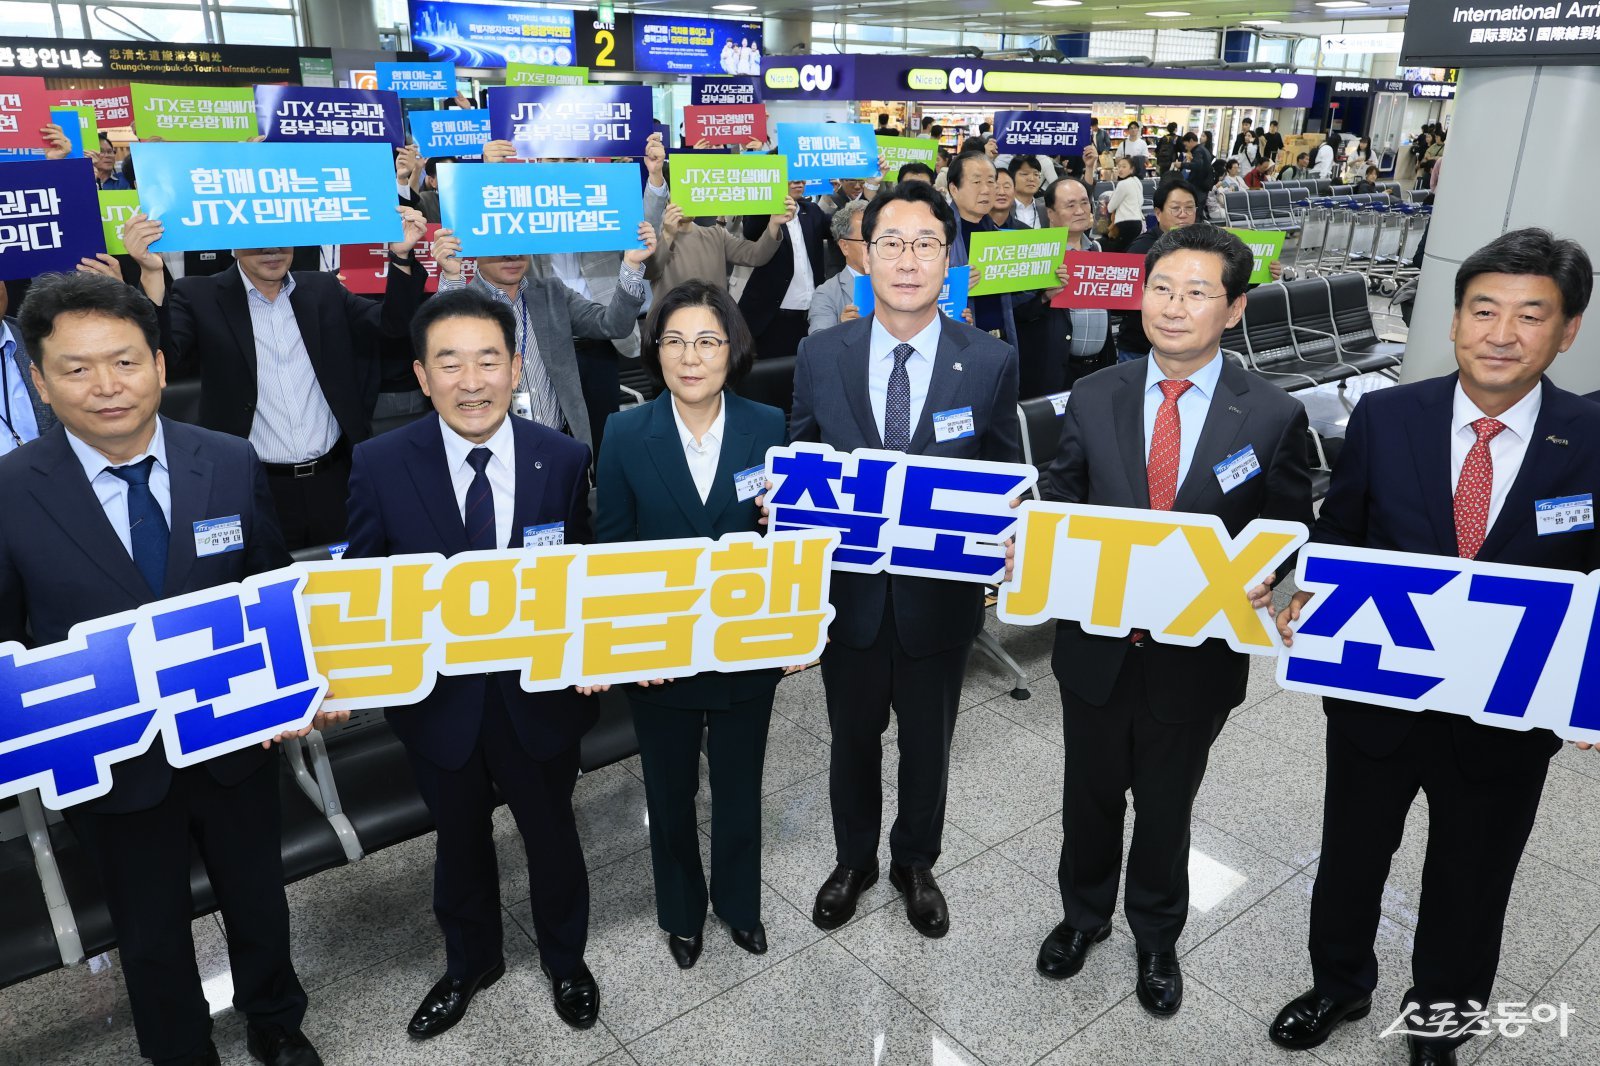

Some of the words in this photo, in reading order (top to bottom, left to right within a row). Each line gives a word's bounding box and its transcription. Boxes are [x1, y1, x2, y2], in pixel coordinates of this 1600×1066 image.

[1453, 2, 1562, 23] International
[593, 21, 615, 30] GATE
[1470, 27, 1528, 43] 国际到达
[595, 30, 616, 67] 2
[0, 47, 103, 68] 관광안내소
[110, 62, 193, 73] Chungcheongbuk-do
[195, 65, 221, 73] Tourist
[222, 65, 265, 74] Information
[266, 66, 290, 74] Center
[392, 71, 411, 80] 함께
[412, 70, 432, 80] 여는
[433, 71, 442, 80] 길
[513, 71, 545, 82] JTX로
[388, 81, 409, 90] JTX
[410, 81, 448, 91] 민자철도
[770, 74, 784, 83] Nice
[785, 75, 793, 83] to
[800, 64, 833, 91] CU
[915, 75, 933, 84] Nice
[934, 76, 943, 84] to
[949, 67, 983, 94] CU
[701, 84, 720, 93] JTX
[721, 84, 754, 94] 수도권과
[144, 97, 195, 114] JTX로
[197, 99, 257, 115] 잠실에서
[701, 94, 735, 104] 중부권을
[277, 100, 315, 118] JTX
[316, 102, 385, 119] 수도권과
[510, 102, 550, 121] JTX
[553, 102, 633, 121] 수도권과
[156, 114, 250, 130] 청주공항까지
[279, 119, 350, 136] 중부권을
[431, 121, 456, 134] 함께
[457, 120, 480, 132] 여는
[697, 113, 755, 125] 국가균형발전
[1005, 120, 1032, 132] JTX
[1032, 121, 1080, 133] 수도권과
[513, 124, 591, 142] 중부권을
[701, 126, 732, 137] JTX로
[732, 125, 752, 135] 실현
[1005, 133, 1053, 145] 중부권을
[428, 135, 454, 147] JTX
[797, 136, 824, 150] 함께
[824, 135, 848, 150] 여는
[848, 136, 861, 150] 길
[793, 152, 820, 168] JTX
[821, 152, 869, 168] 민자철도
[897, 147, 933, 161] 잠실에서
[190, 167, 257, 195] 함께
[259, 167, 319, 194] 여는
[321, 167, 353, 193] 길
[680, 168, 727, 185] JTX로
[727, 168, 780, 184] 잠실에서
[481, 185, 533, 208] 함께
[535, 184, 582, 207] 여는
[584, 184, 608, 206] 길
[690, 185, 773, 202] 청주공항까지
[181, 199, 249, 226] JTX
[252, 196, 371, 225] 민자철도
[471, 211, 524, 236] JTX
[528, 209, 621, 234] 민자철도
[978, 245, 1016, 263] JTX로
[1017, 242, 1061, 260] 잠실에서
[984, 260, 1052, 280] 청주공항까지
[1073, 264, 1140, 281] 국가균형발전
[1074, 282, 1111, 297] JTX로
[1111, 283, 1133, 298] 실현
[769, 451, 1023, 578] 철도
[1008, 509, 1295, 648] JTX
[306, 535, 834, 700] 광역급행
